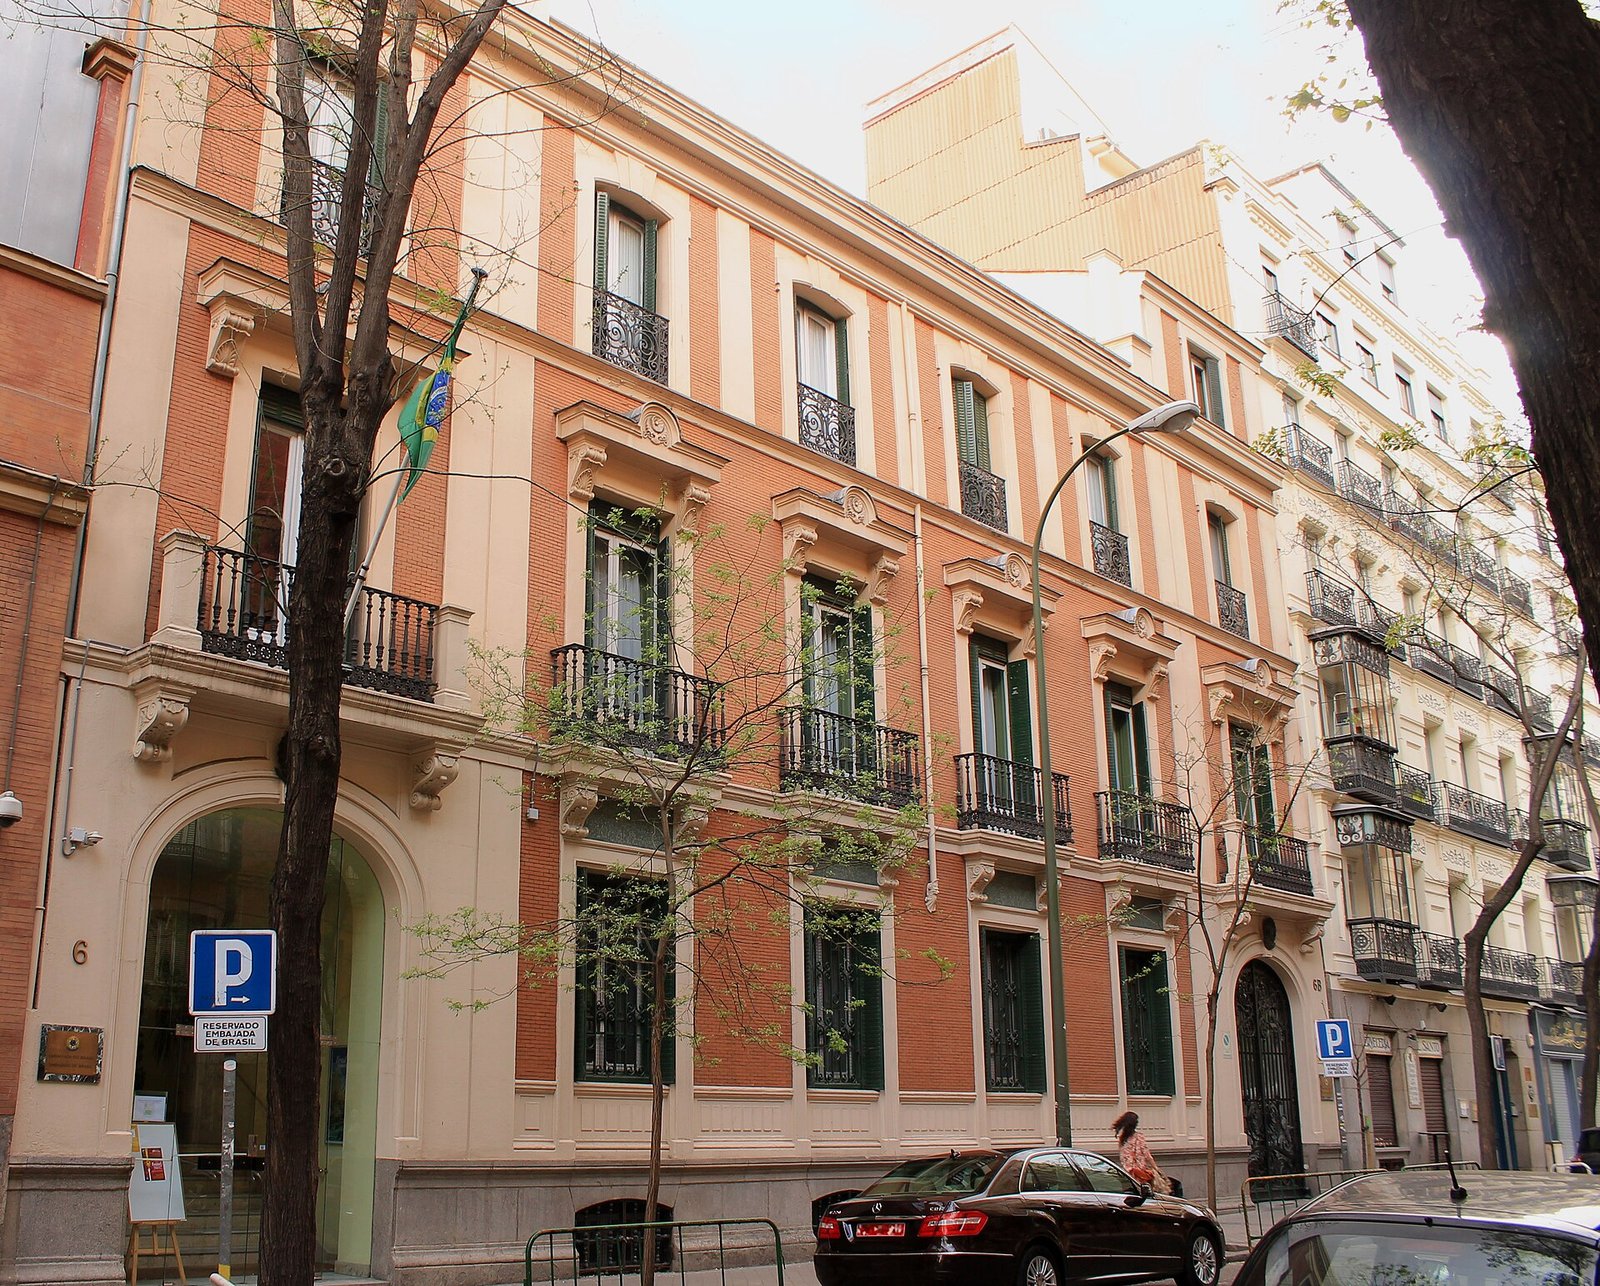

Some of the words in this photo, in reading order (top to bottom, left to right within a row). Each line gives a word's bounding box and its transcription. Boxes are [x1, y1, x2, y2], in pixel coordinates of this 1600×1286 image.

[72, 939, 88, 964] 6
[214, 939, 253, 1006] P
[202, 1022, 260, 1030] RESERVADO
[205, 1030, 256, 1038] EMBAJADA
[205, 1038, 219, 1046] DE
[221, 1038, 257, 1046] BRASIL
[1325, 1023, 1343, 1056] P
